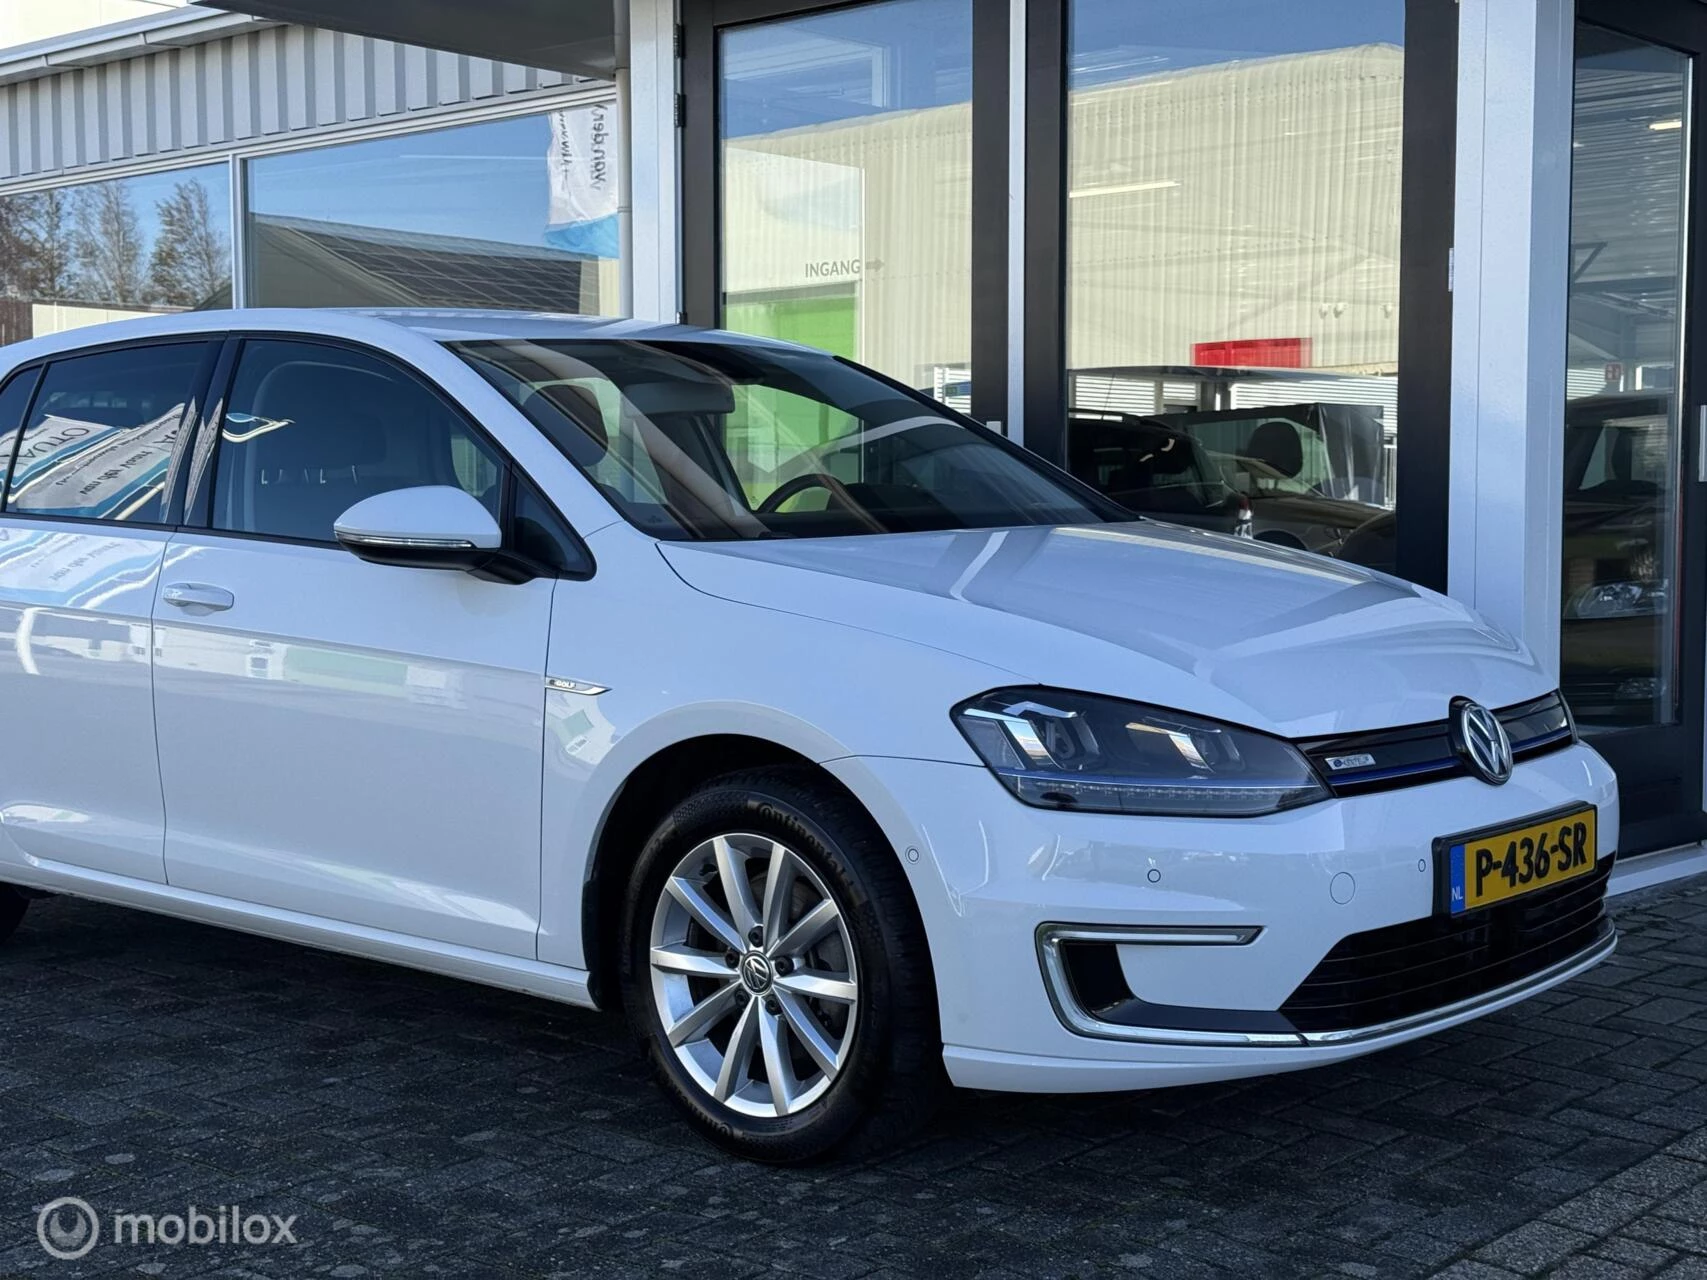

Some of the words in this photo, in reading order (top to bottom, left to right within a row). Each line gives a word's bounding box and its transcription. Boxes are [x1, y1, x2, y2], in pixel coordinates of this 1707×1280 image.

[805, 259, 861, 278] INGANG
[1475, 821, 1588, 898] P-436-SR
[1451, 885, 1464, 902] NL
